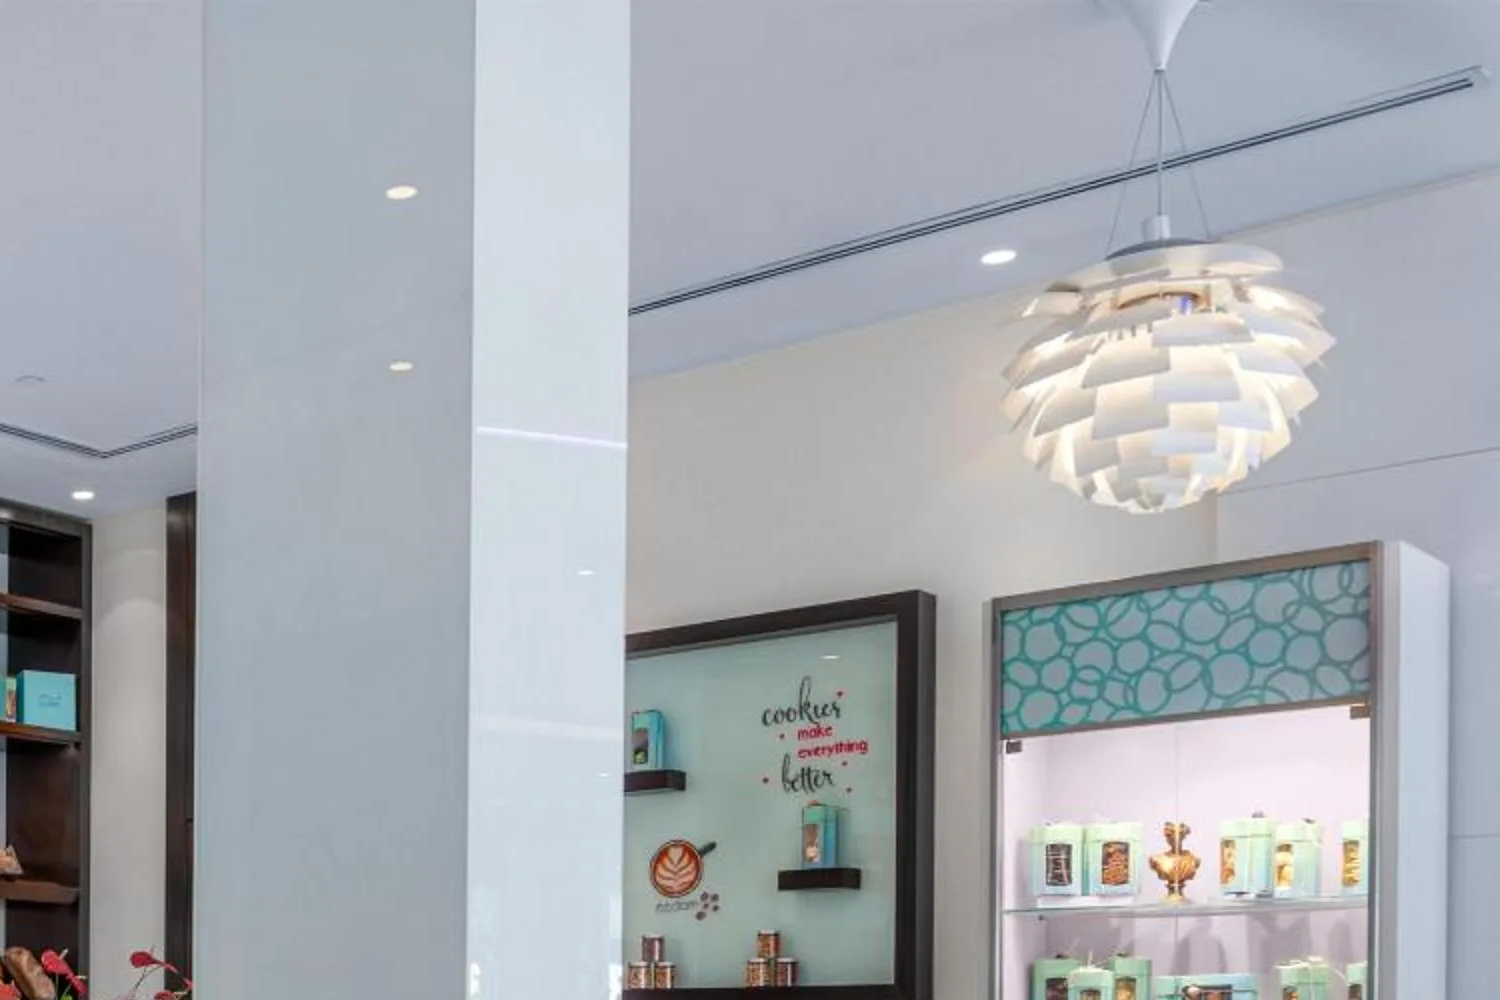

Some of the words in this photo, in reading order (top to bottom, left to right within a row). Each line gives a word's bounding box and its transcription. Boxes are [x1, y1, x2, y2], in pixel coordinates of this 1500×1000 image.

[797, 726, 833, 741] make
[797, 740, 869, 759] everything
[781, 753, 835, 794] better
